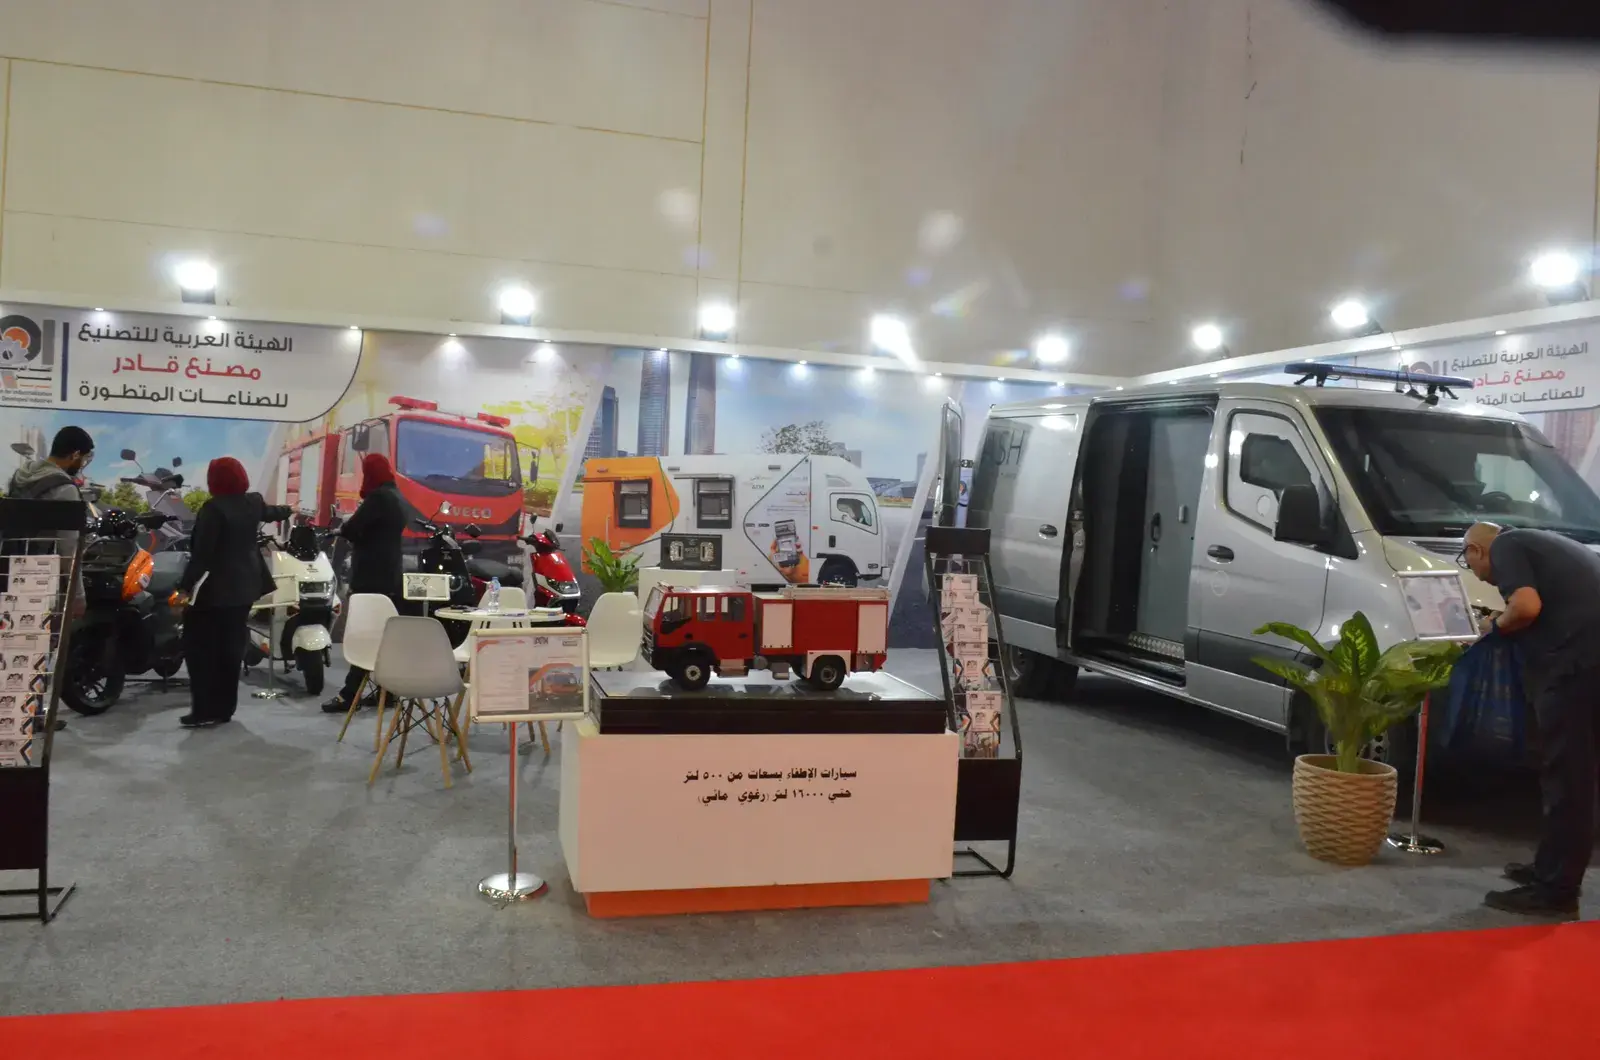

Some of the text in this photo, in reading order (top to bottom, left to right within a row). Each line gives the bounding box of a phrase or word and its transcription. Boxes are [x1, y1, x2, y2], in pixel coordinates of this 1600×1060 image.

[78, 323, 293, 353] الهيئة العربية للتصنيع
[1500, 347, 1544, 365] العربية
[1546, 341, 1588, 360] الهيئة
[112, 354, 261, 381] مصنع قادر
[1451, 353, 1498, 372] للتصنيع
[1513, 368, 1566, 386] مصنع
[79, 380, 288, 408] للصناعات المتطورة
[1510, 386, 1586, 404] للصناعات
[683, 767, 857, 784] سيارات الإطفاء بسعات من ٥٠٠ لتر
[772, 788, 788, 802] لتر
[792, 788, 824, 799] ١٦٠٠٠
